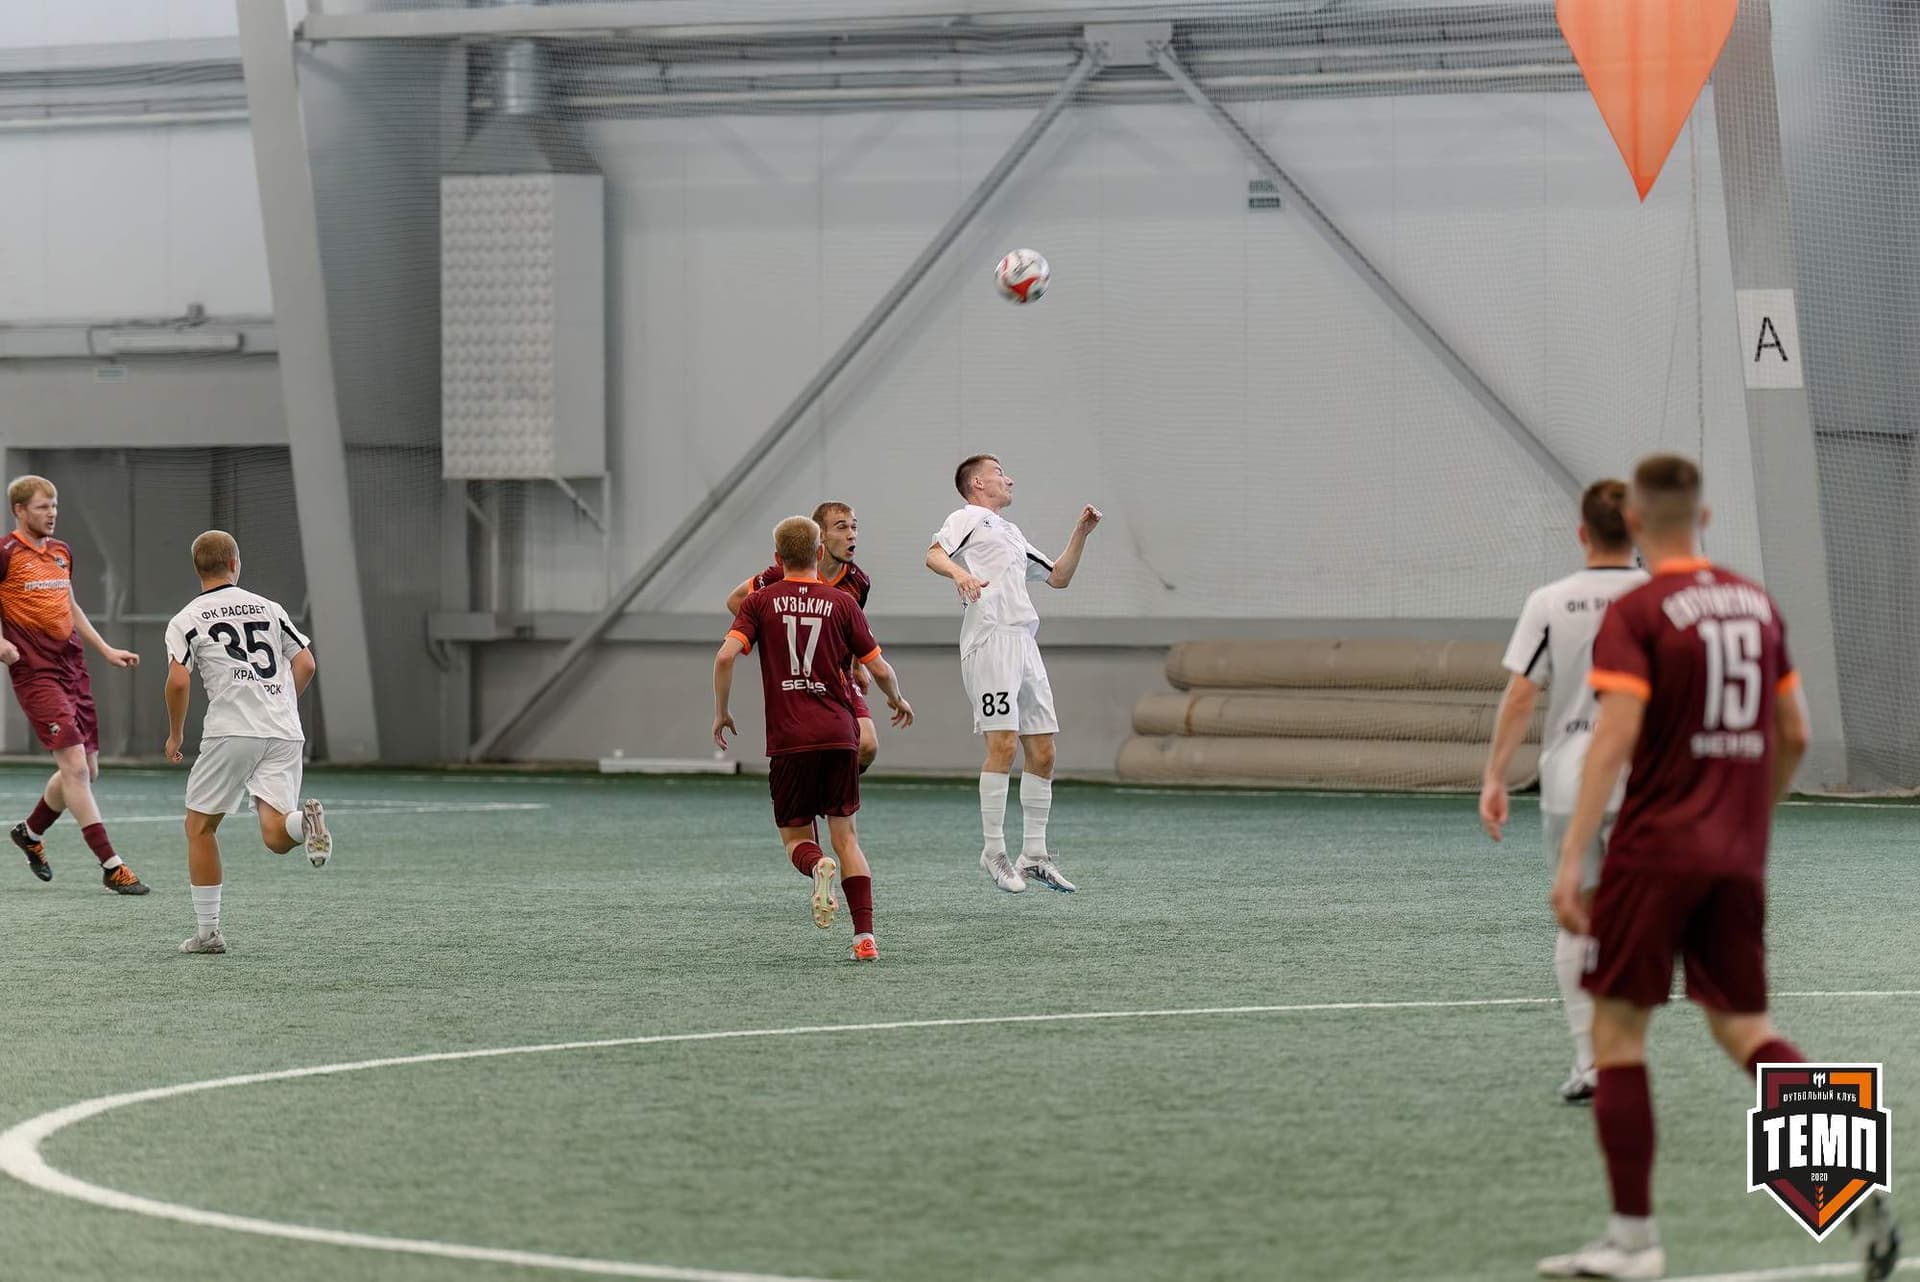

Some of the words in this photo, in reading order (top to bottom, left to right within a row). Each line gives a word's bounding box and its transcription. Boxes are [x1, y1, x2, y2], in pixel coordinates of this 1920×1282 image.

[1754, 316, 1788, 362] А
[201, 609, 219, 620] ФК
[220, 604, 265, 617] РАССВЕТ
[773, 596, 833, 617] КУЗЬКИН
[208, 621, 277, 679] 35
[783, 615, 822, 677] 17
[1697, 617, 1763, 731] 15
[982, 692, 1010, 717] 83
